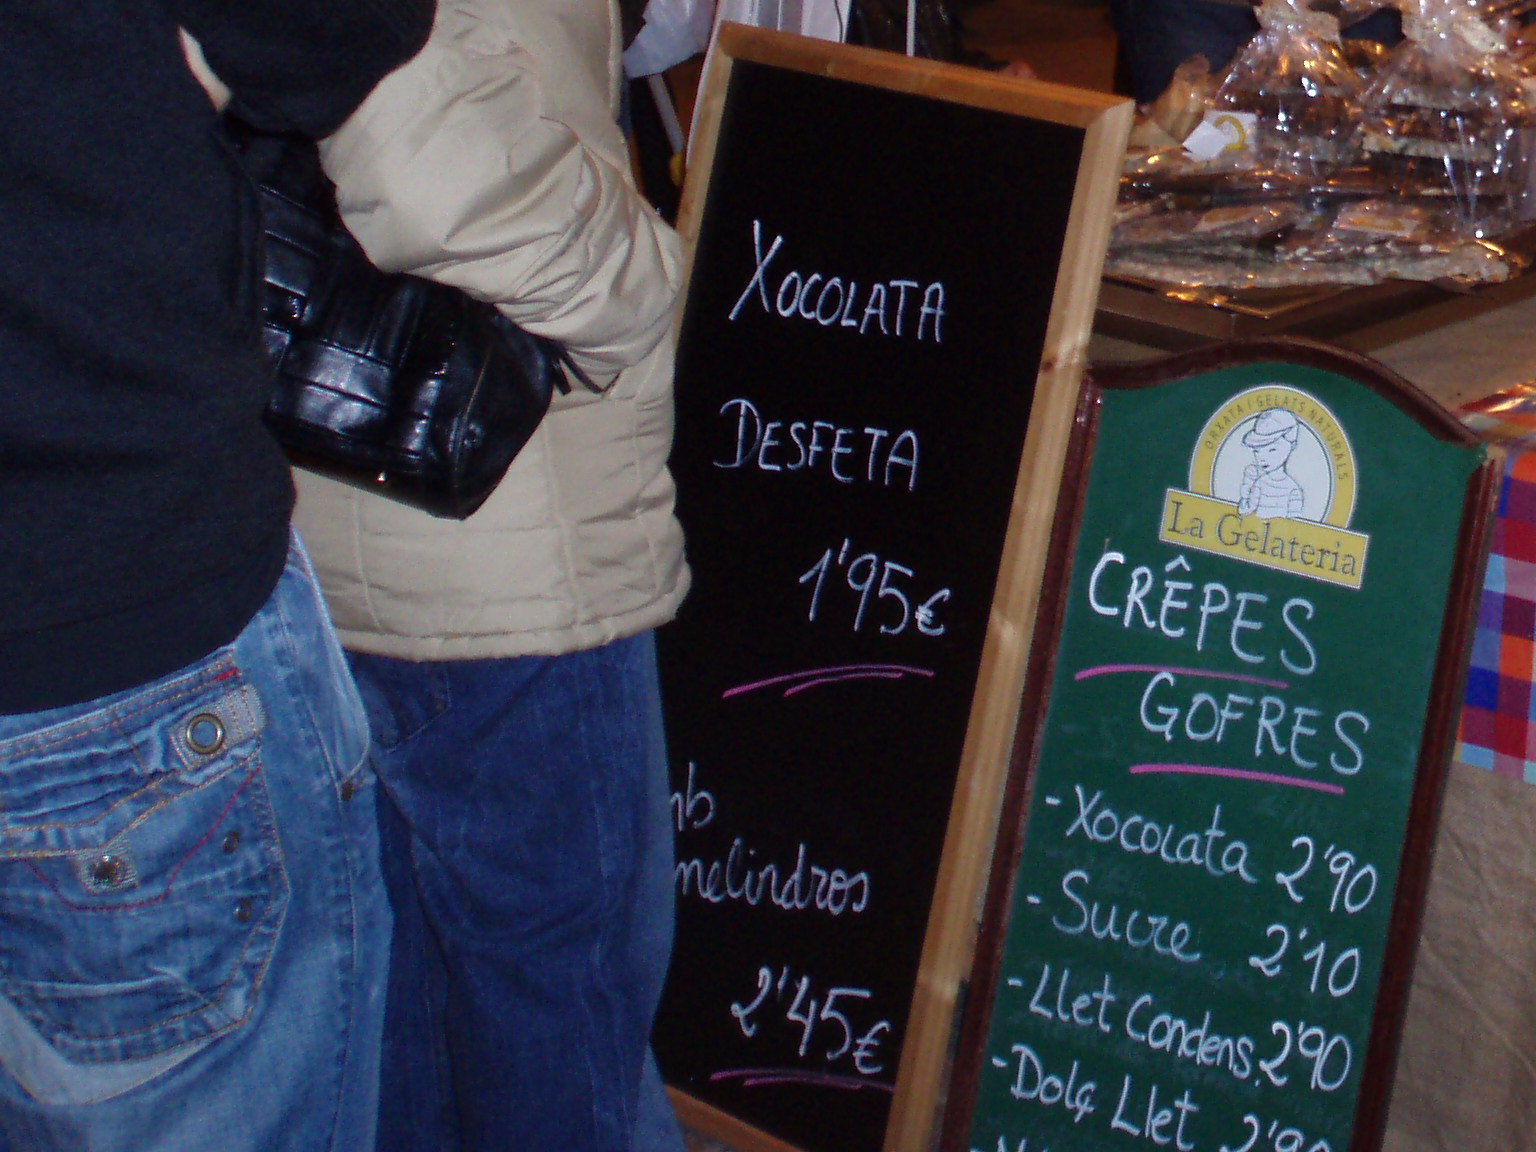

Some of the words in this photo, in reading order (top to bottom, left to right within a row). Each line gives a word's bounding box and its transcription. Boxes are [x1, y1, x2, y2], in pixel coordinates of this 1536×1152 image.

[712, 398, 920, 492] DESFETA
[1204, 404, 1244, 450] ORXATA
[1255, 394, 1306, 414] GELATS
[1308, 407, 1350, 481] NATURALS
[1167, 500, 1204, 539] La
[1216, 513, 1357, 577] Gelateria
[1088, 552, 1317, 676] CRÊPES
[1139, 672, 1371, 776] GOFRES
[674, 836, 871, 916] melindros
[1111, 1074, 1202, 1152] Llet
